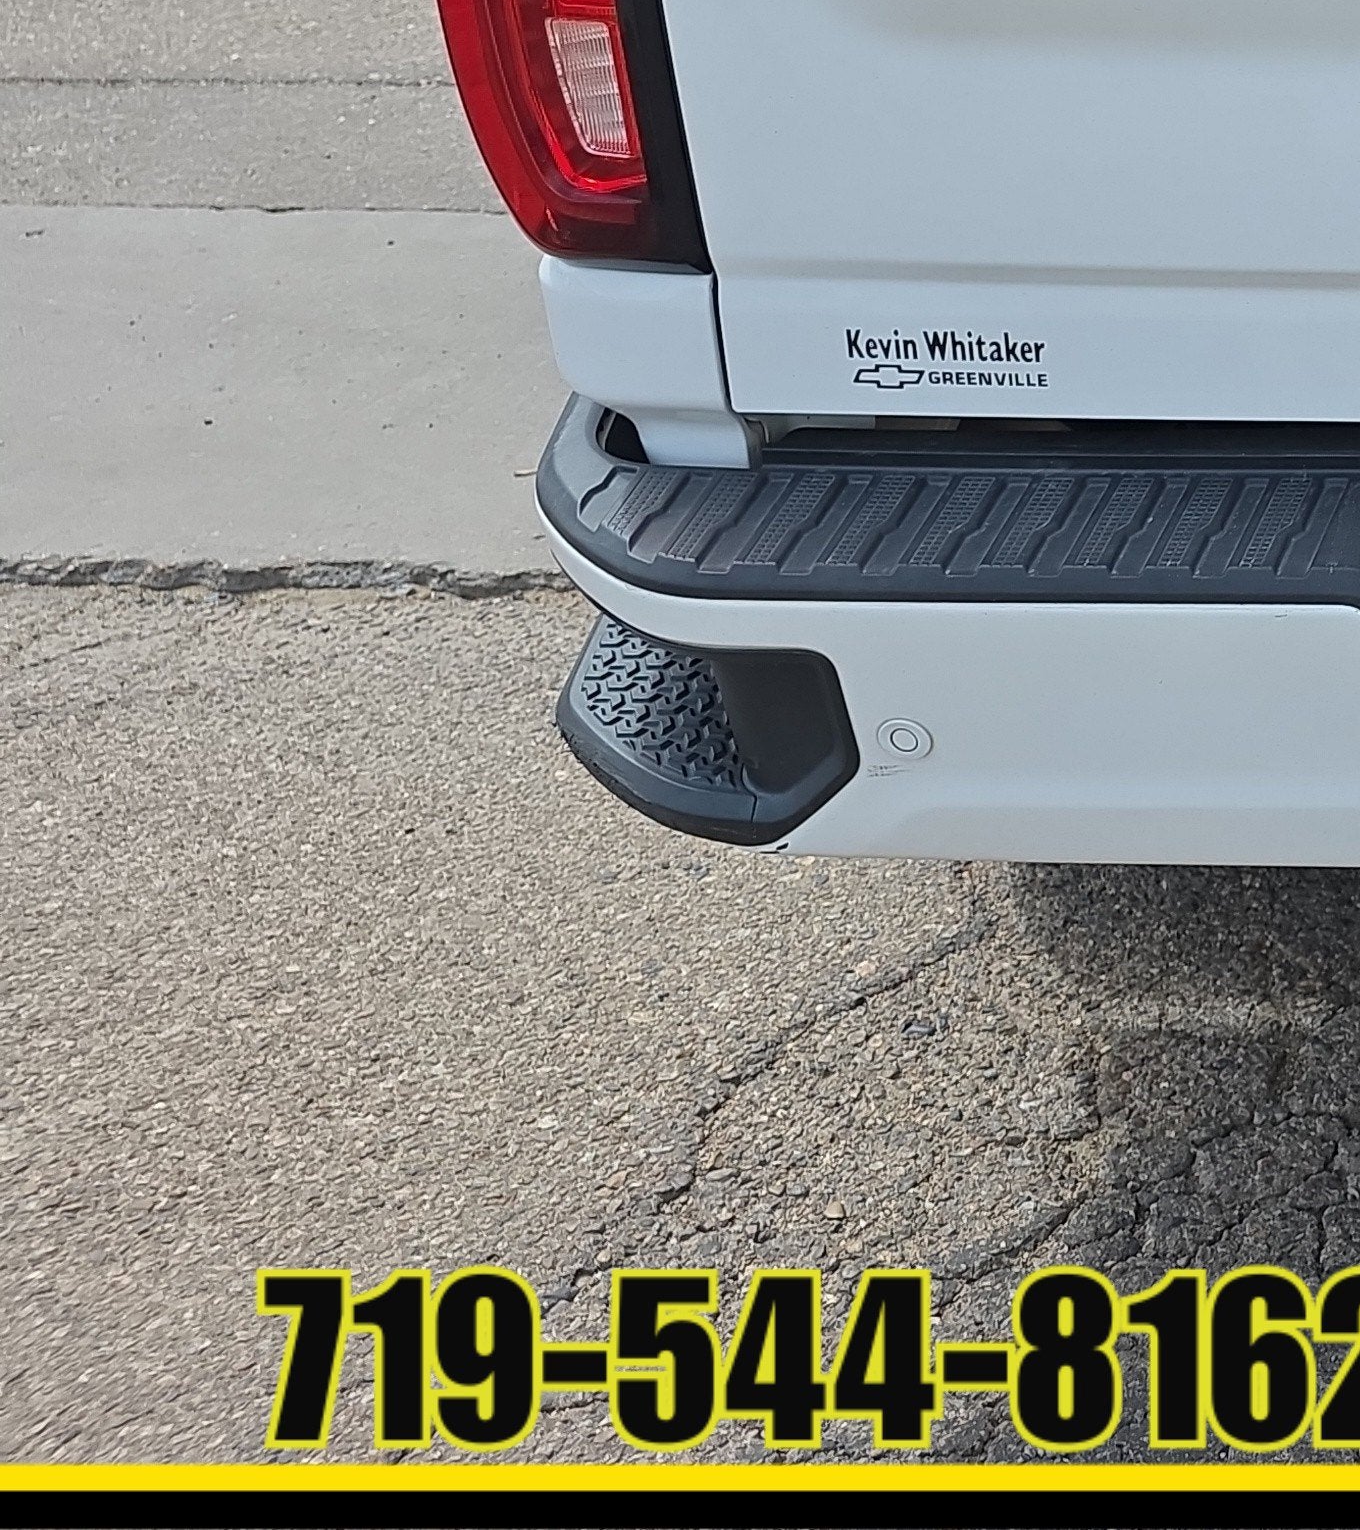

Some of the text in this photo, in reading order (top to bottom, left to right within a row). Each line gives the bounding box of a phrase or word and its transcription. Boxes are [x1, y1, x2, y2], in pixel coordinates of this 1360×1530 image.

[845, 328, 1046, 363] Kevin Whitaker
[927, 371, 1049, 387] GREENVILLE
